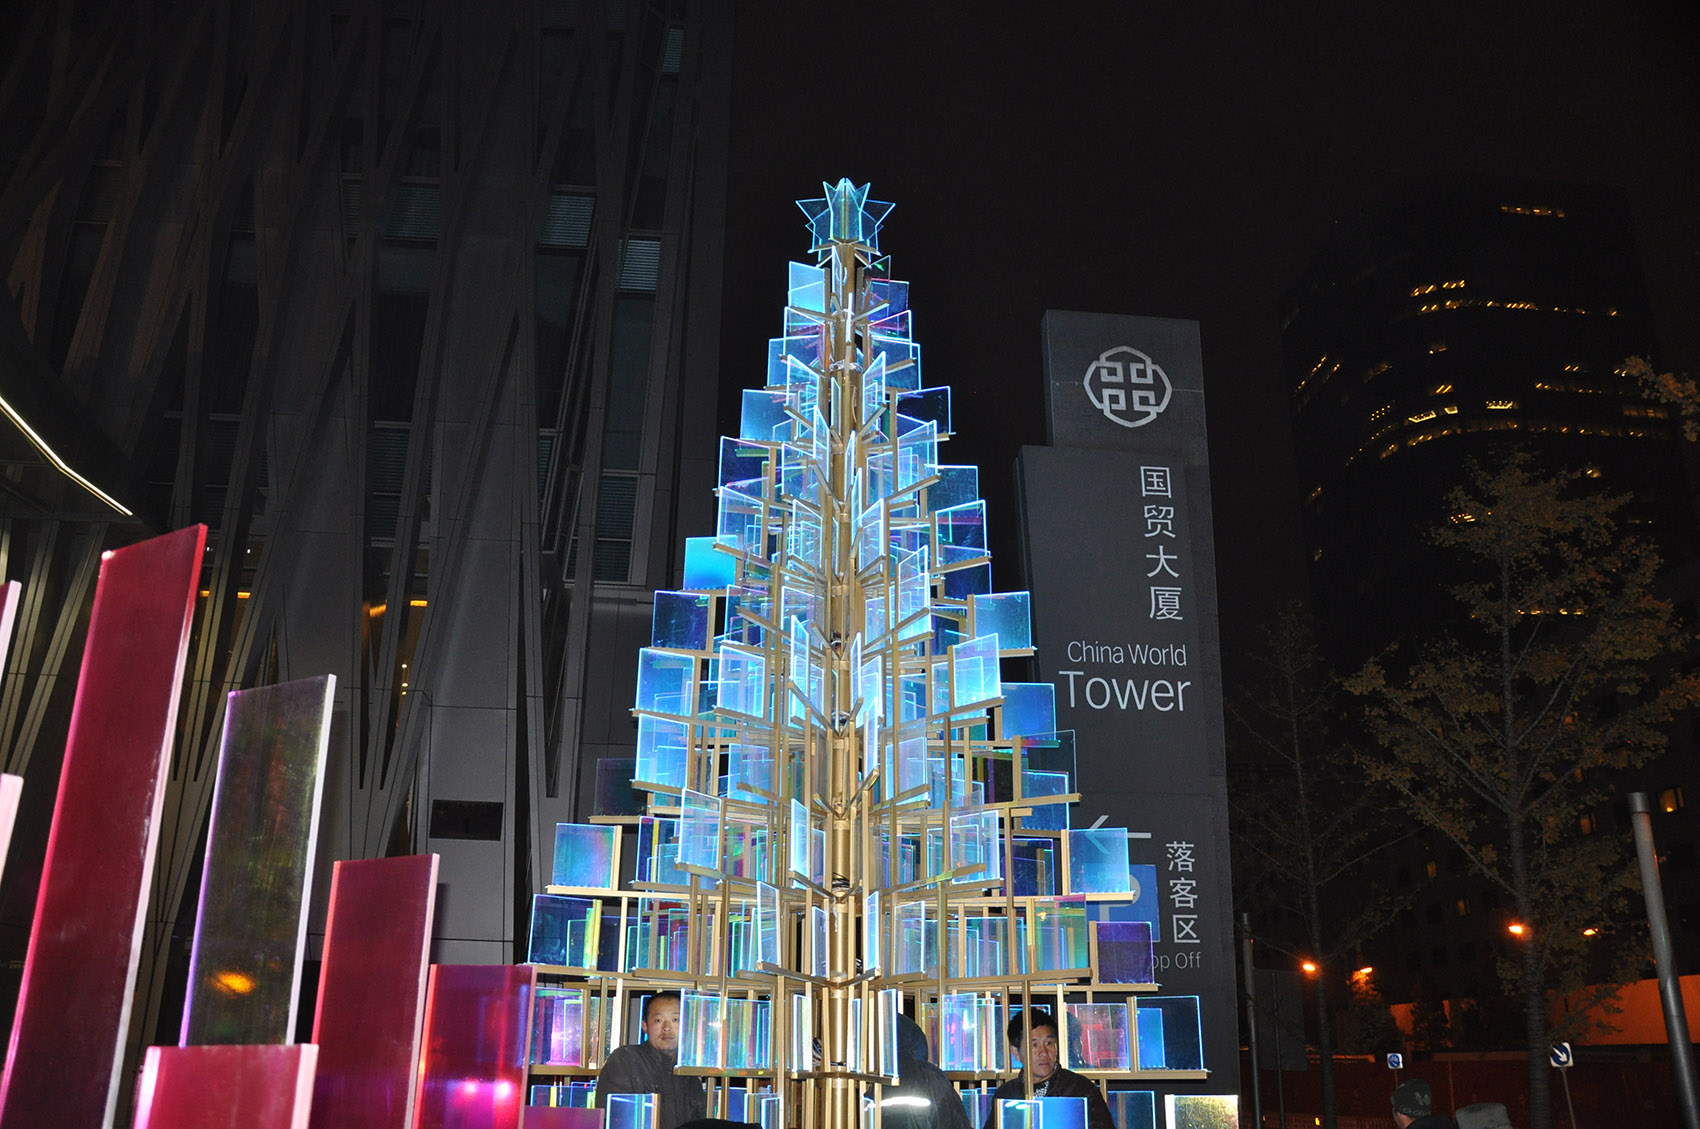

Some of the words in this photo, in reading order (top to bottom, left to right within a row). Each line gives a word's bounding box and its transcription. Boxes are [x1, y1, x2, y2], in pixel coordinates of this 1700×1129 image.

[1139, 465, 1183, 620] 国贸大厦
[1067, 640, 1124, 664] China
[1127, 643, 1187, 666] World
[1058, 670, 1191, 712] Tower
[1165, 840, 1200, 943] 落客区
[1175, 951, 1201, 969] Off
